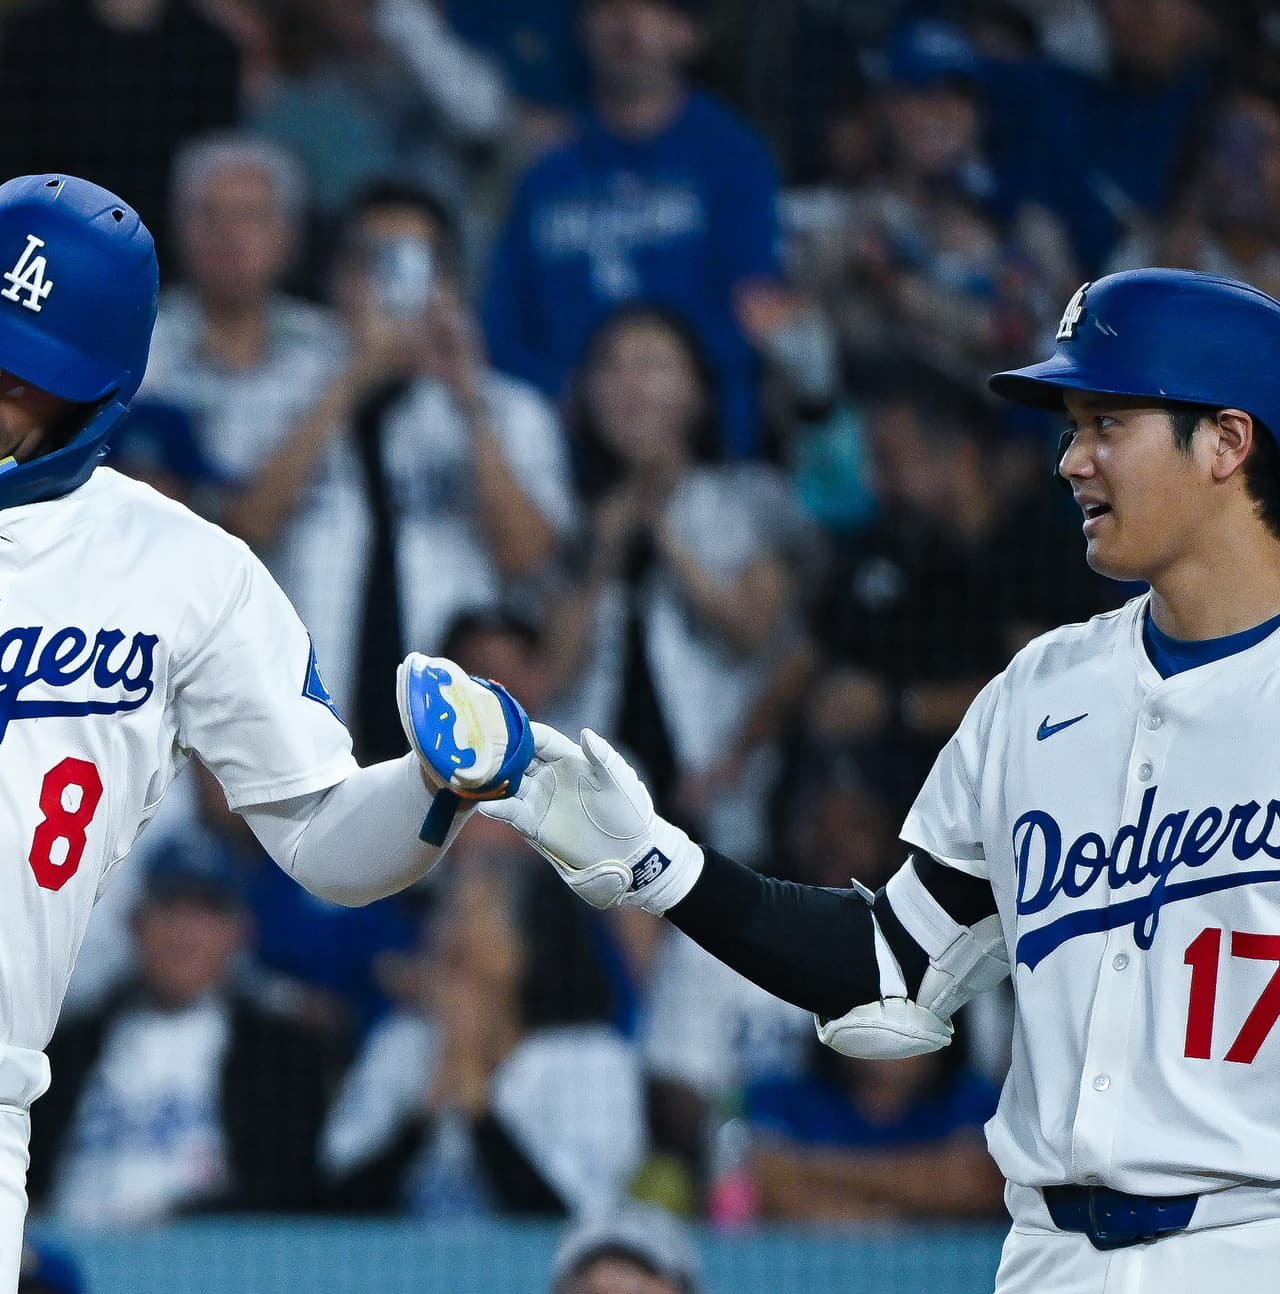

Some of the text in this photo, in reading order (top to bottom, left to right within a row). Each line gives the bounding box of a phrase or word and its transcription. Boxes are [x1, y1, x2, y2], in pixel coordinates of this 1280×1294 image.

[0, 234, 54, 312] LA
[28, 756, 103, 892] 8
[1184, 927, 1280, 1064] 17
